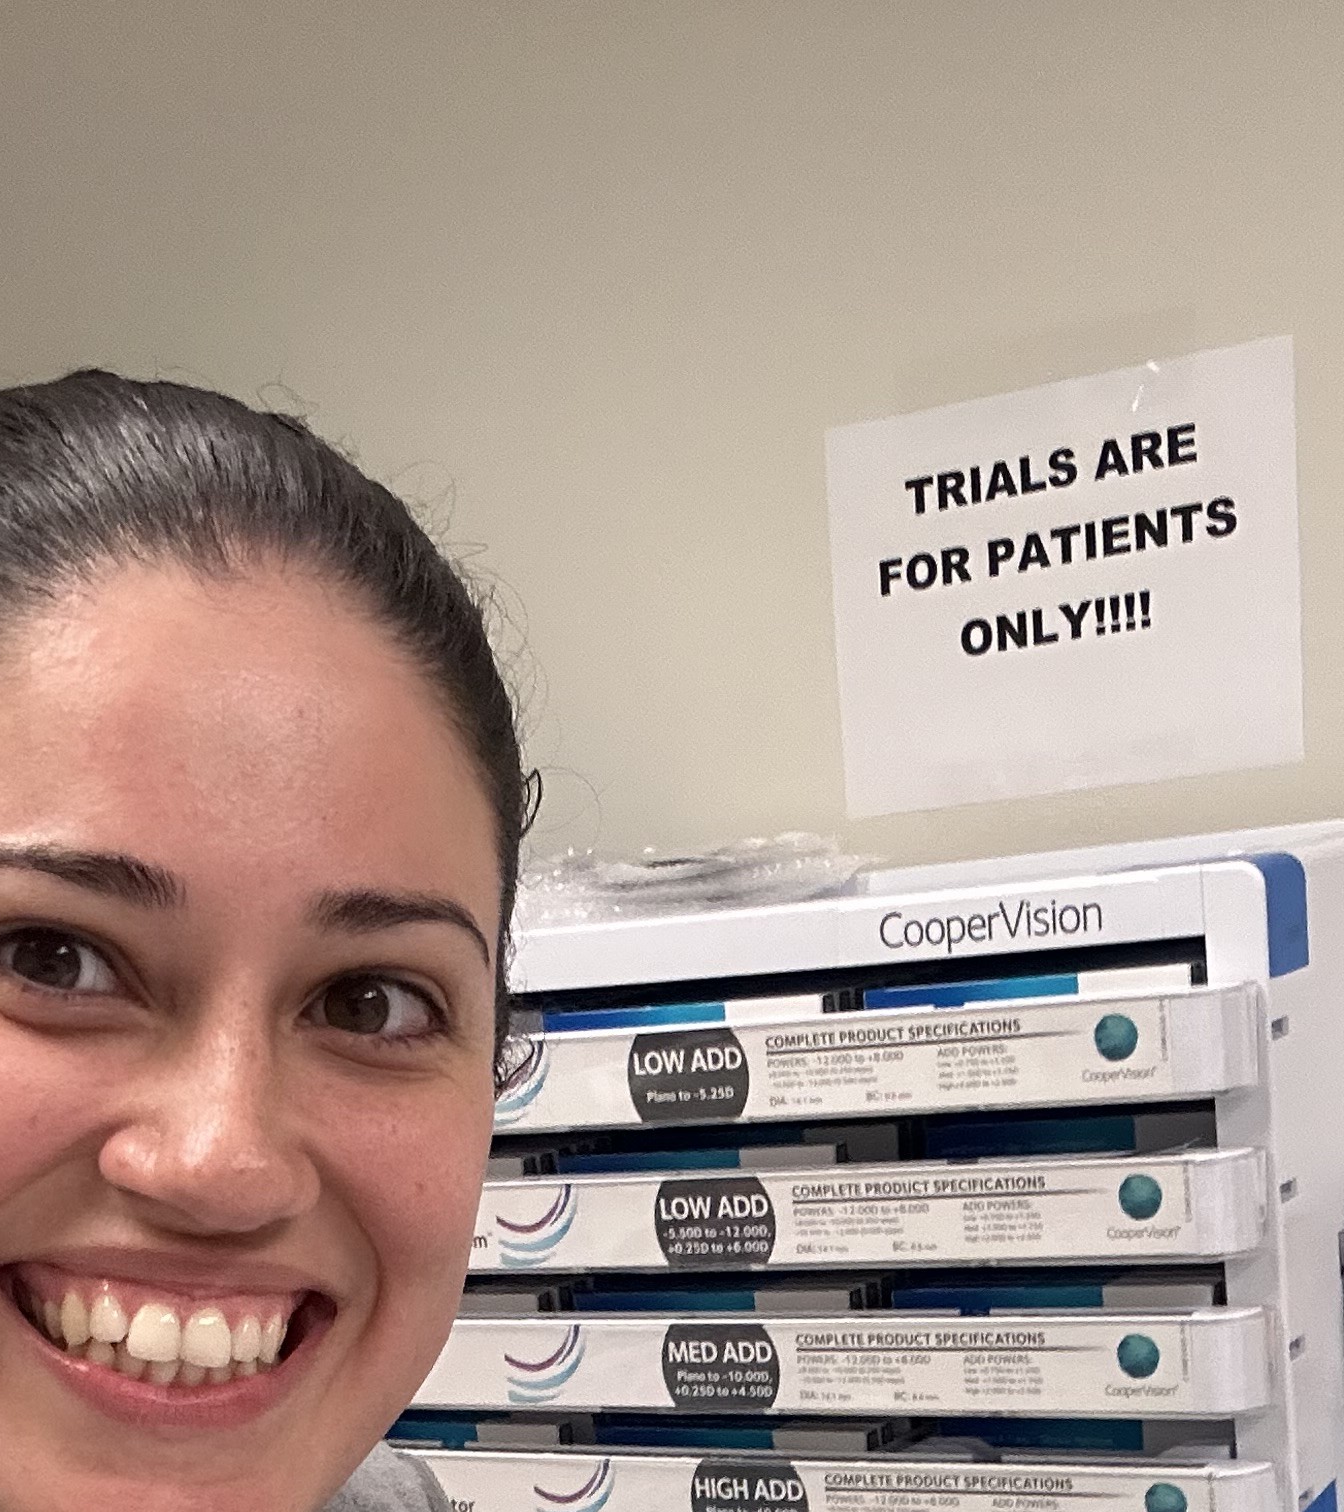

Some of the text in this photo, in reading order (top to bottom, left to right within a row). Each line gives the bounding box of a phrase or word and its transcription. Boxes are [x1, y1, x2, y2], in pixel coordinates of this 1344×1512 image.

[905, 423, 1197, 514] TRIALS ARE
[879, 497, 1238, 597] FOR PATIENTS
[961, 590, 1151, 656] ONLY!!!!
[879, 899, 1103, 954] CooperVision
[765, 1019, 1021, 1049] COMPLETE PRODUCT SPECIFICATIONS
[633, 1046, 742, 1076] LOW ADD
[791, 1175, 1046, 1198] COMPLETE PRODUCT SPECIFICATIONS
[659, 1194, 768, 1221] LOW ADD
[1107, 1224, 1178, 1241] CooperVision
[795, 1331, 1045, 1347] COMPLETE PRODUCT SPECIFICATIONS
[667, 1341, 772, 1364] MED ADD
[1105, 1383, 1177, 1398] CooperVision
[695, 1478, 804, 1502] HIGH ADD
[824, 1473, 1073, 1491] COMPLETE PRODUCT SPECIFICATIONS
